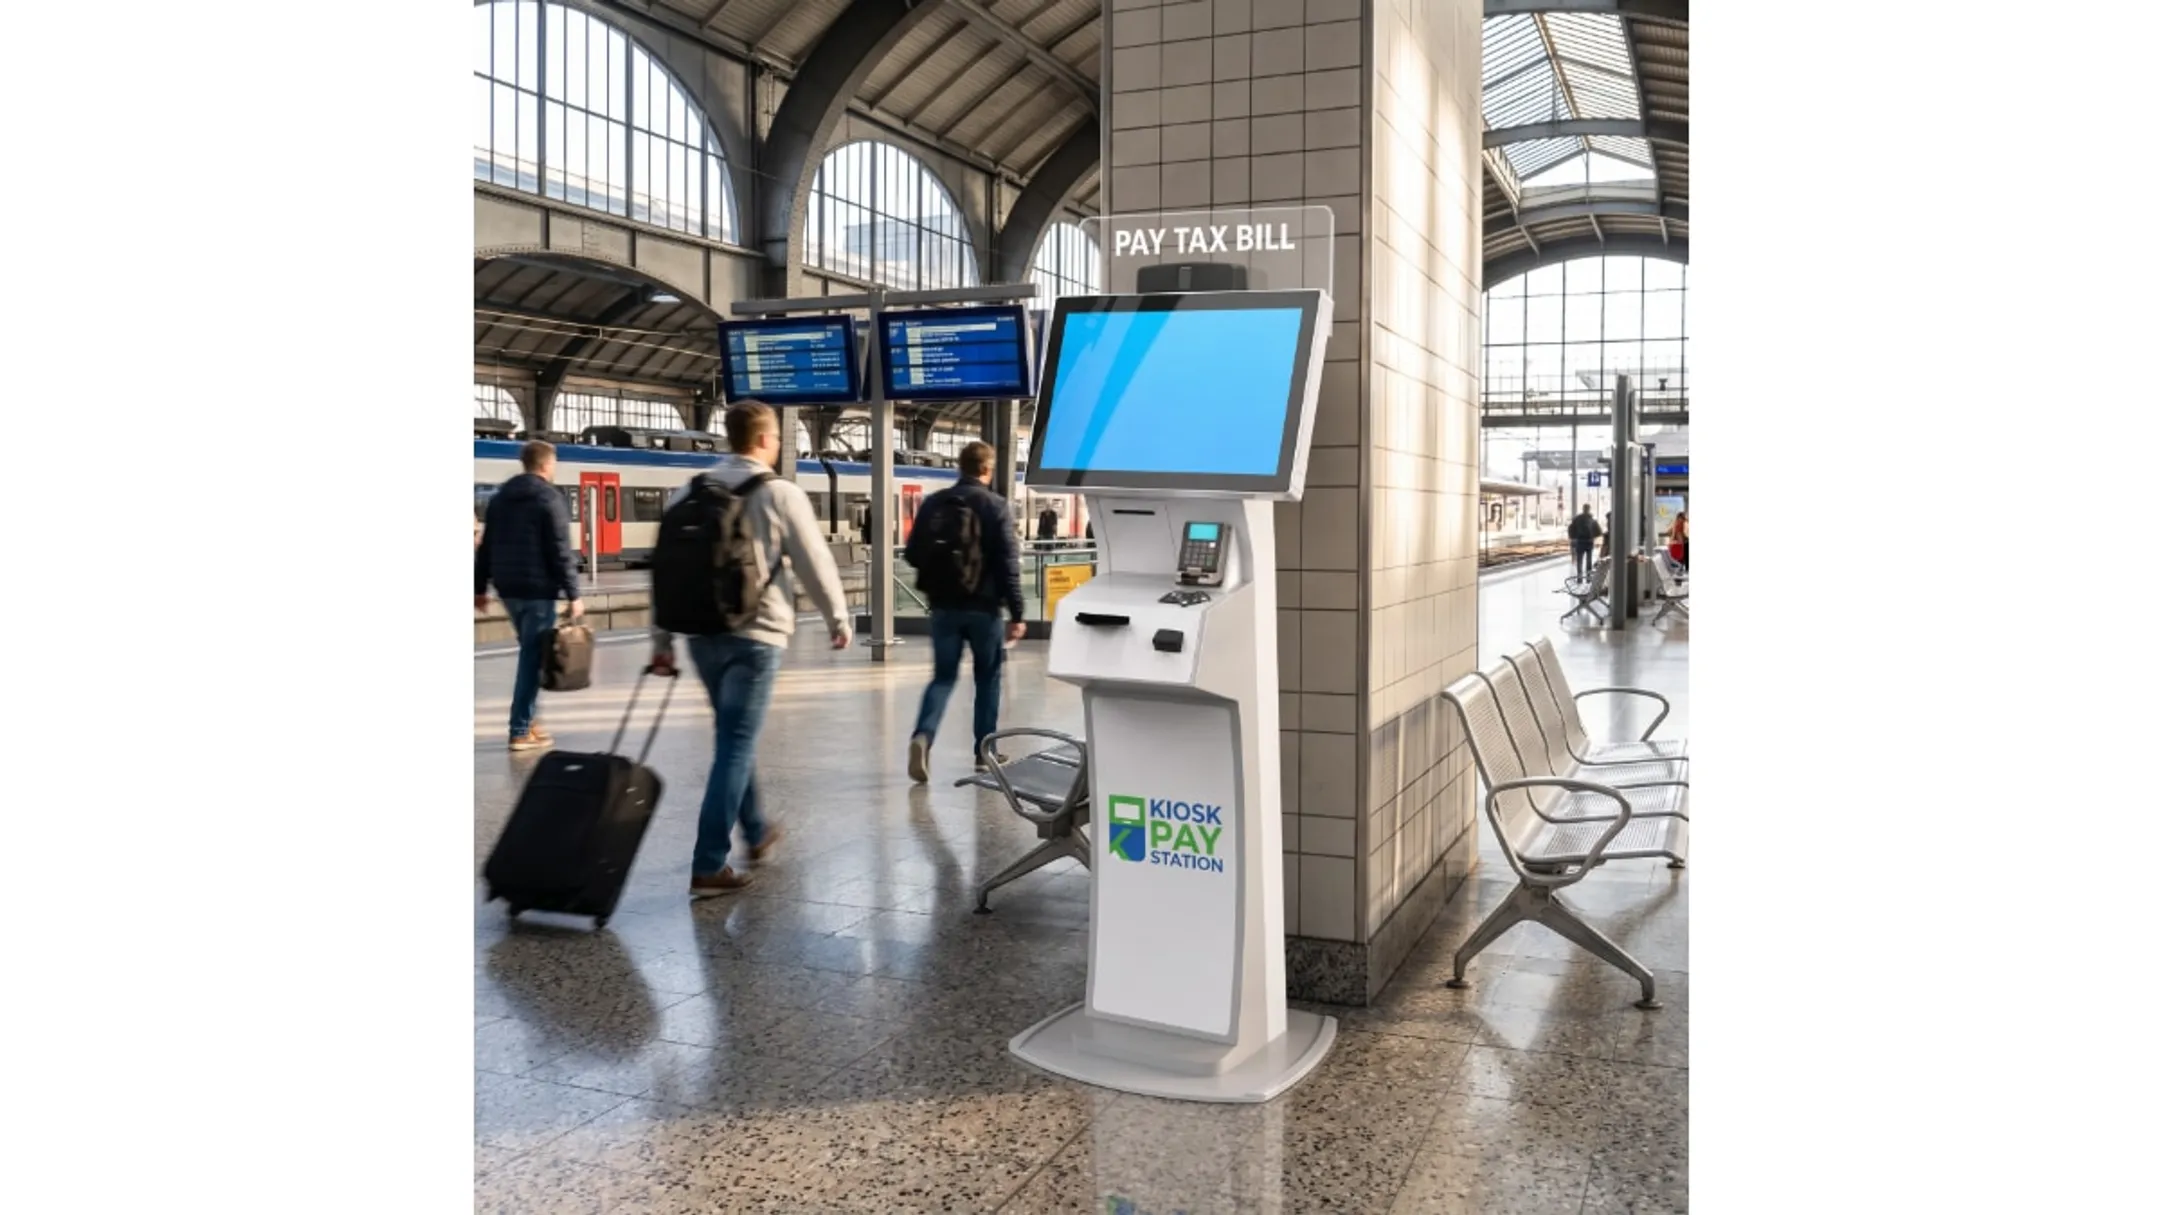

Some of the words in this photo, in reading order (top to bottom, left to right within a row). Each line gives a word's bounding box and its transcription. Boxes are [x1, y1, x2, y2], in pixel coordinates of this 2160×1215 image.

[1115, 228, 1167, 257] PAY
[1173, 225, 1228, 254] TAX
[1236, 223, 1295, 252] BILL
[1150, 798, 1222, 825] KIOSK
[1150, 820, 1223, 856] PAY
[1150, 850, 1224, 873] STATION
